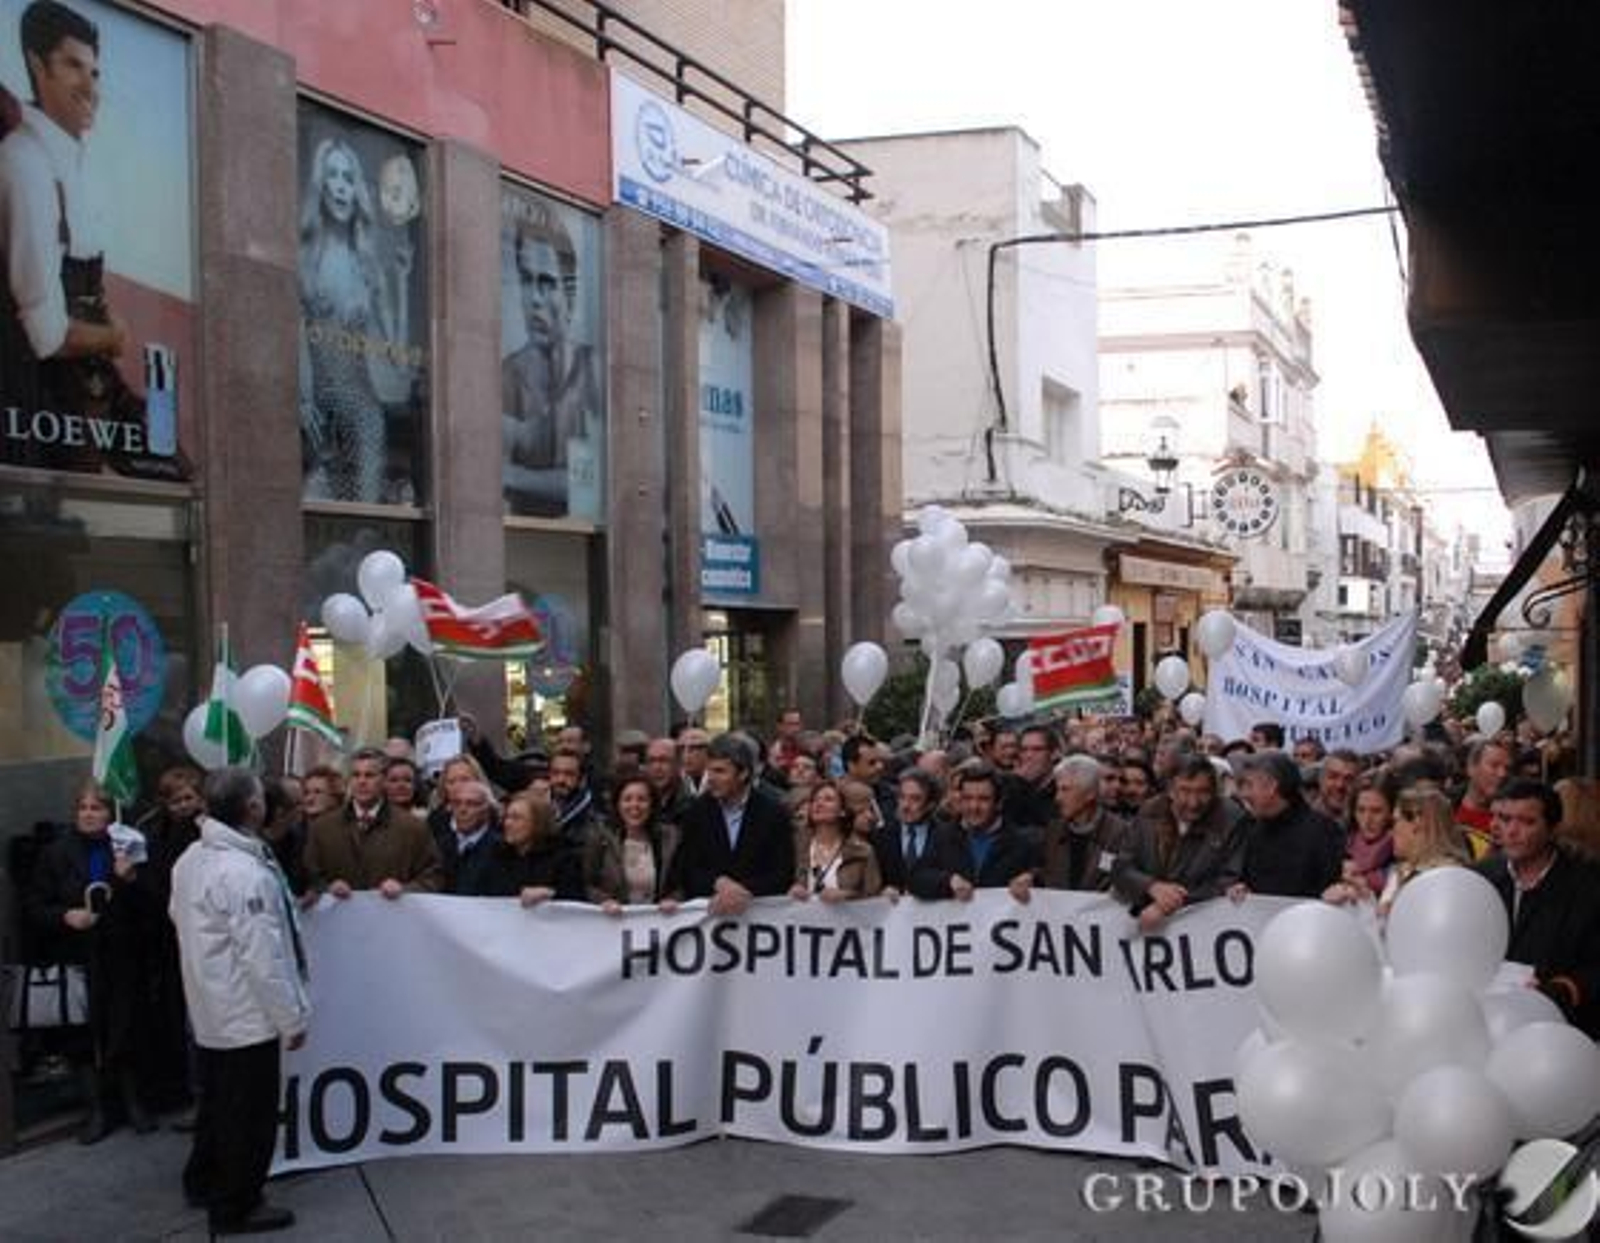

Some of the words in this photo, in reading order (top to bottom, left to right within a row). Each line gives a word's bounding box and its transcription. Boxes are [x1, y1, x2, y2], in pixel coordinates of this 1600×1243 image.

[4, 406, 144, 452] LOEWE
[1224, 674, 1344, 716] HOSPITAL
[621, 919, 900, 980] HOSPITAL
[912, 923, 974, 979] DE
[991, 919, 1104, 979] SAN
[719, 1035, 1092, 1144] PÚBLICO
